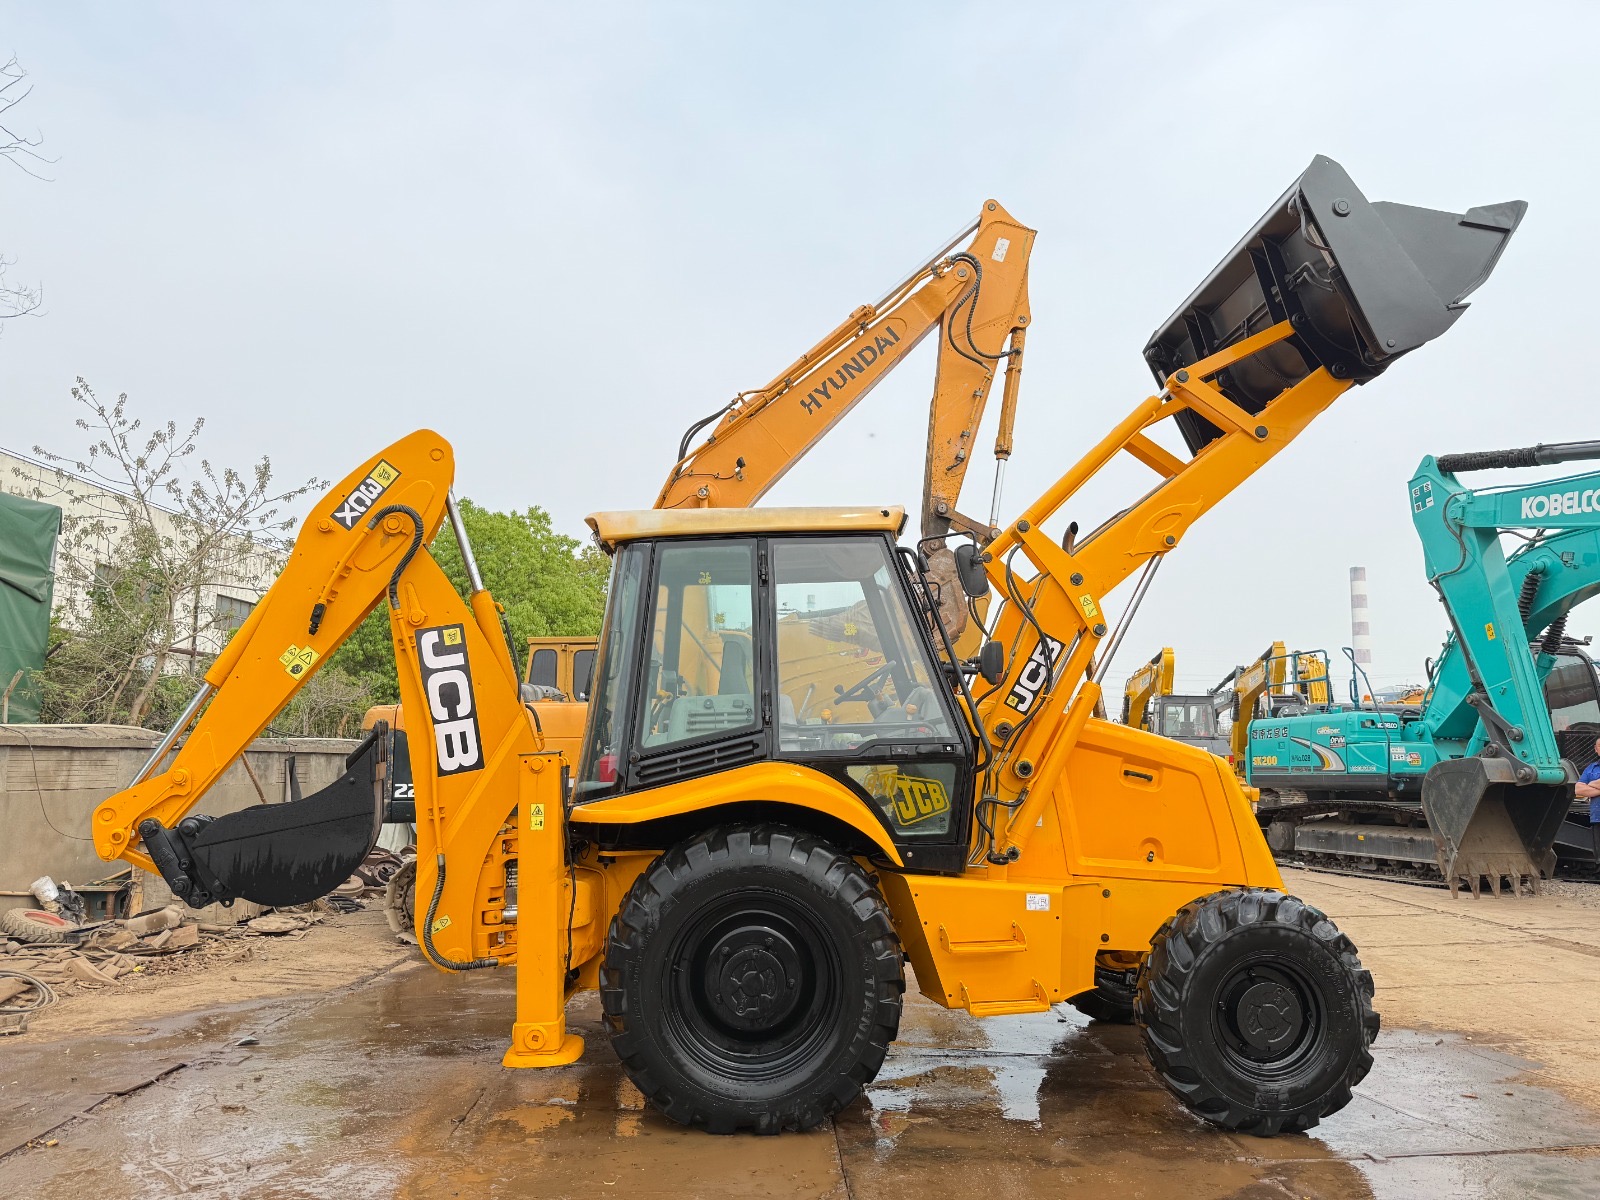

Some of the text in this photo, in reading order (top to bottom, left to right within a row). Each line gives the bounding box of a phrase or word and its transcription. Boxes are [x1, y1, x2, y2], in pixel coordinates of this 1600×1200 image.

[799, 325, 901, 416] HYUNDAI
[333, 478, 384, 528] 3CX
[421, 630, 479, 771] JCB
[1013, 637, 1062, 712] JCB
[1253, 756, 1277, 765] SK200
[897, 779, 945, 820] JCB
[849, 975, 876, 1056] TIANLI
